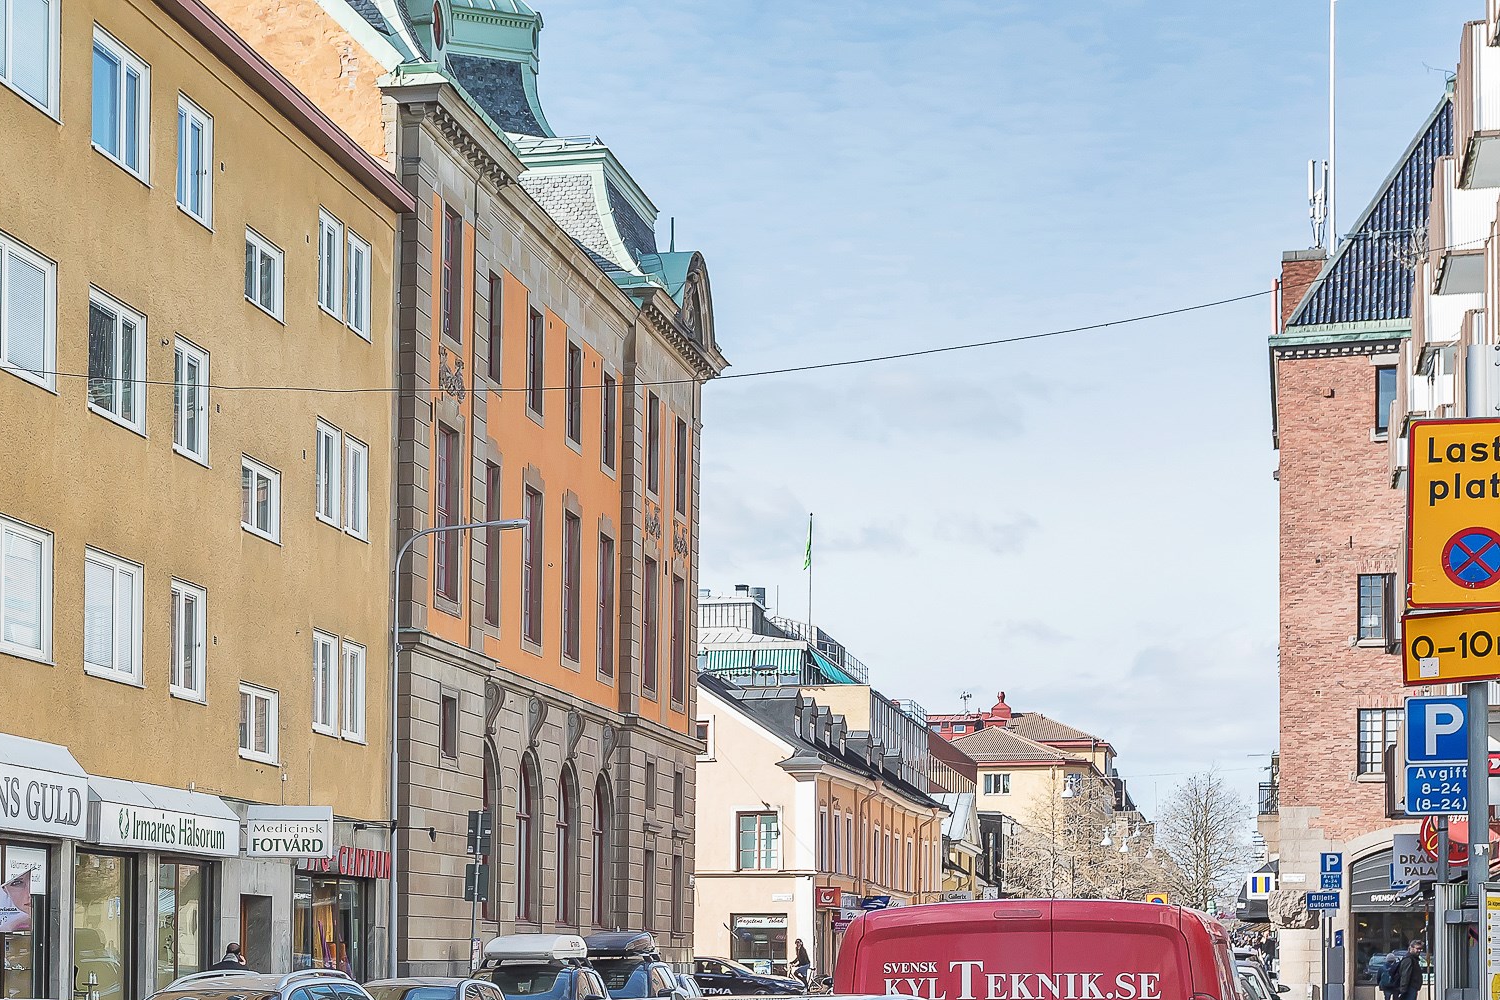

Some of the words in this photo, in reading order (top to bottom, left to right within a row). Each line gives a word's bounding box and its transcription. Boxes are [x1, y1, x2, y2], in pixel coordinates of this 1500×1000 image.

[1411, 630, 1500, 662] 0-10
[1425, 703, 1464, 756] P
[1415, 767, 1468, 781] Avgift
[1421, 782, 1462, 795] 8-24
[26, 780, 82, 827] GULD
[1416, 796, 1467, 812] (8-24)
[133, 811, 176, 845] Irmaries
[179, 817, 225, 850] Hälsorum
[253, 823, 323, 834] Medicinsk
[252, 833, 324, 853] FOTVÅRD
[1325, 854, 1339, 872] P
[883, 961, 938, 974] SVENSK
[699, 986, 733, 995] TIMA
[883, 977, 947, 1000] KYL
